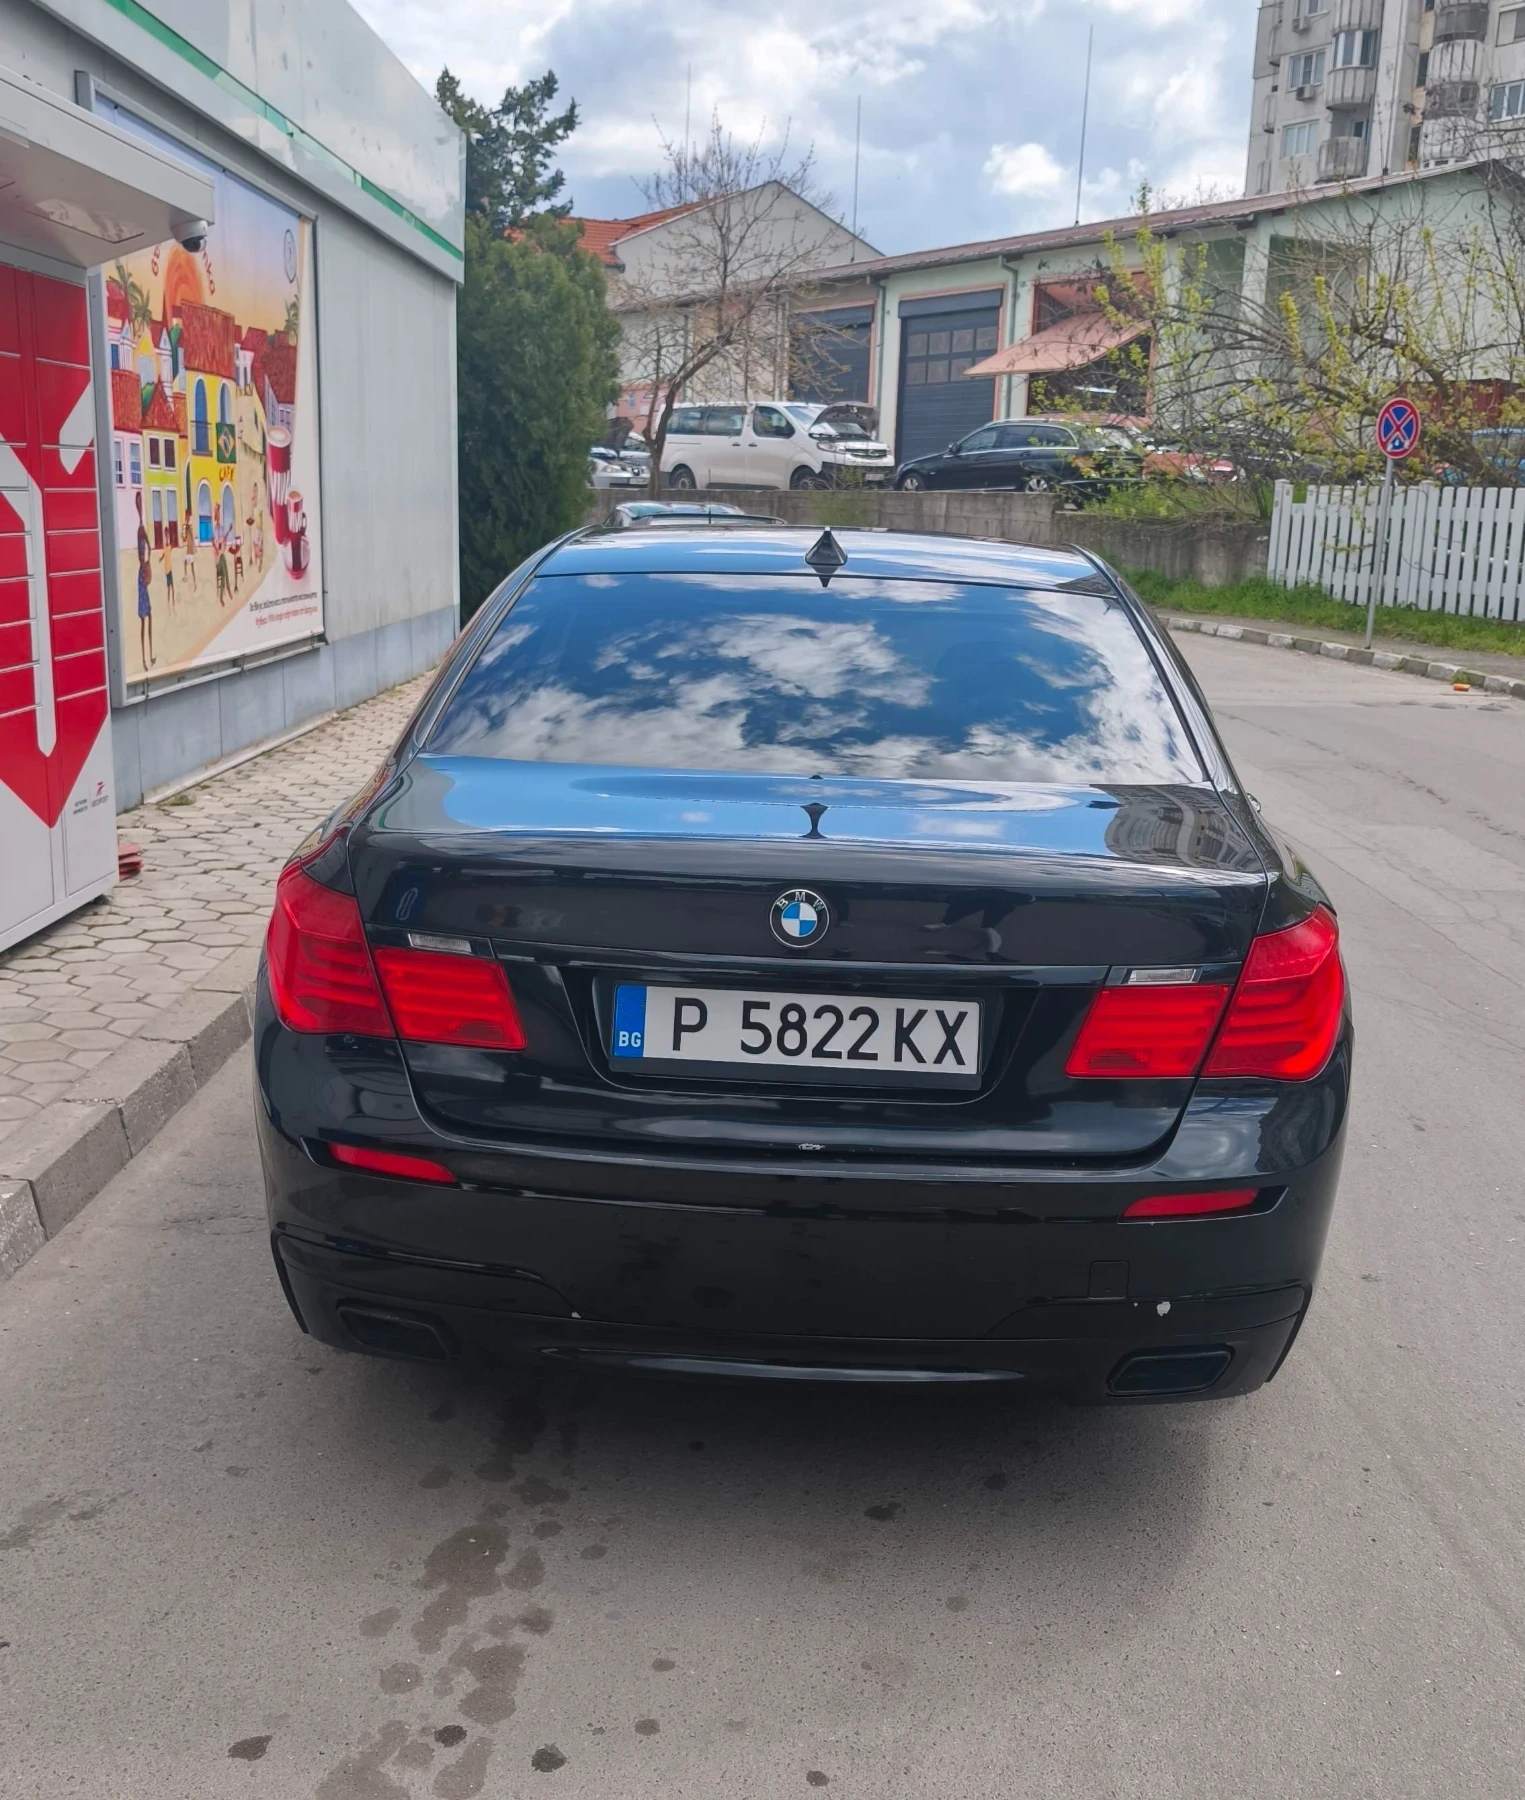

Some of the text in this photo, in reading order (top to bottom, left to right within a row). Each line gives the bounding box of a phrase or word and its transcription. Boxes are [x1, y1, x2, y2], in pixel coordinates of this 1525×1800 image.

[776, 891, 825, 912] BMW
[671, 996, 708, 1051] P
[618, 1031, 641, 1048] BG
